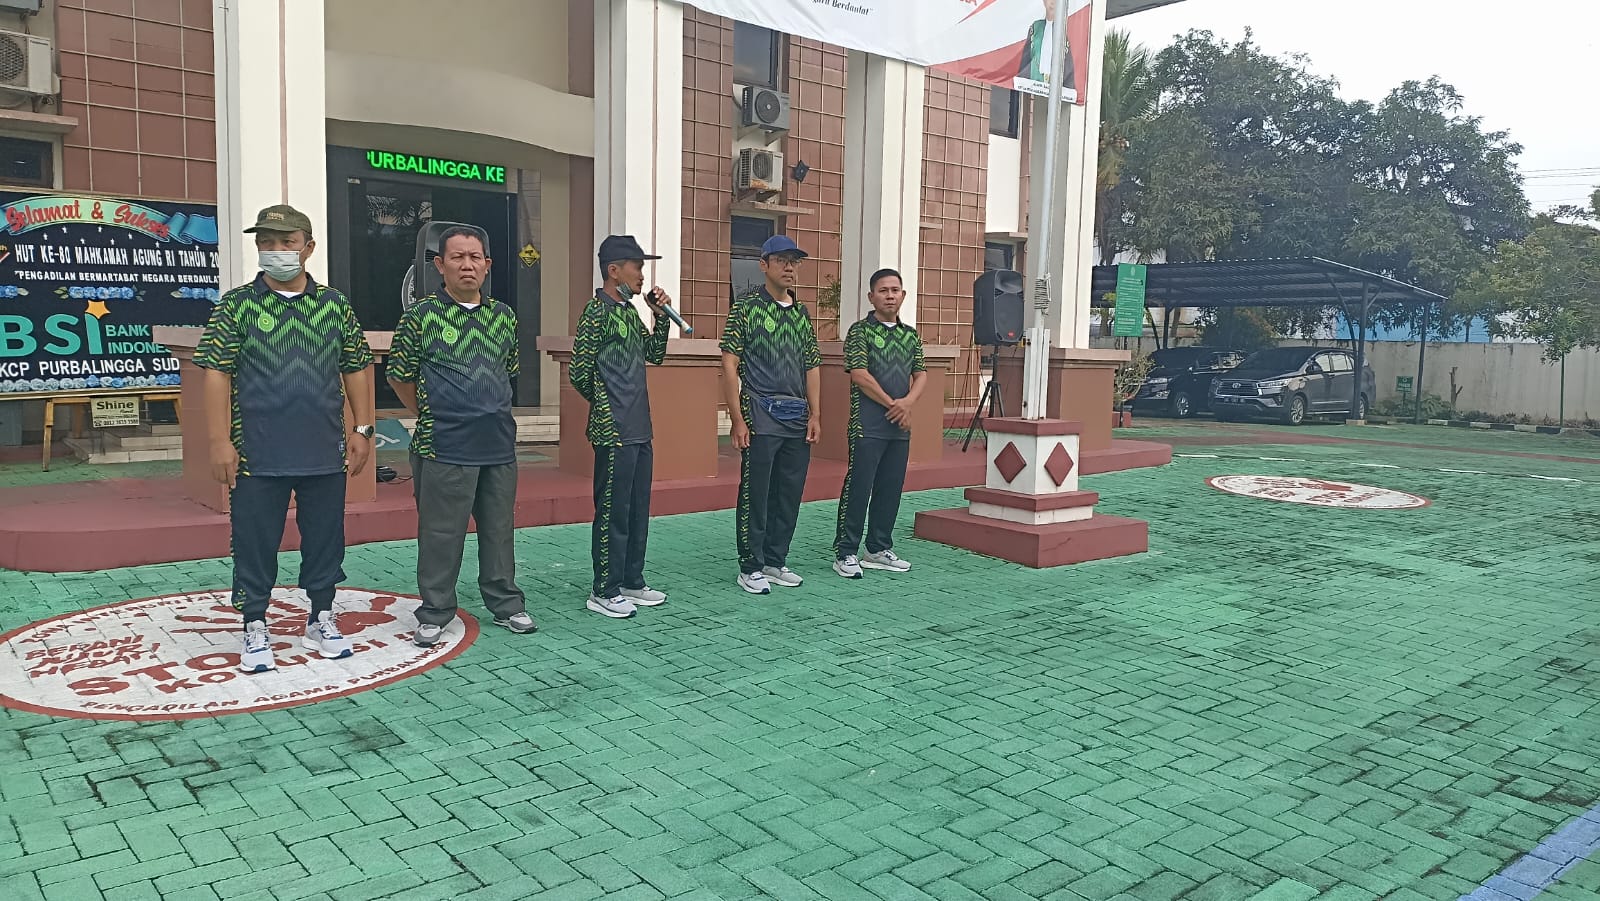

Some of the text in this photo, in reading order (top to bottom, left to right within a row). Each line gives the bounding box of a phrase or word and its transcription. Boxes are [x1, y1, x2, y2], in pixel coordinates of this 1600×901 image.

[485, 166, 505, 183] KE
[6, 199, 170, 239] Selamat & Sukses
[15, 244, 34, 263] HUT
[40, 245, 71, 264] KE-80
[75, 246, 128, 266] MAHKAMAH
[133, 248, 162, 267] AGUNG
[165, 250, 176, 267] RI
[178, 250, 207, 268] TAHUN
[79, 272, 138, 282] BERMARTABAT
[142, 273, 175, 282] NEGARA
[0, 312, 103, 357] BSI
[105, 324, 150, 337] BANK
[0, 357, 180, 377] KCP PURBALINGGA SUD
[96, 401, 134, 410] Shine
[80, 700, 240, 713] PENGADILAN
[253, 684, 340, 703] AGAMA
